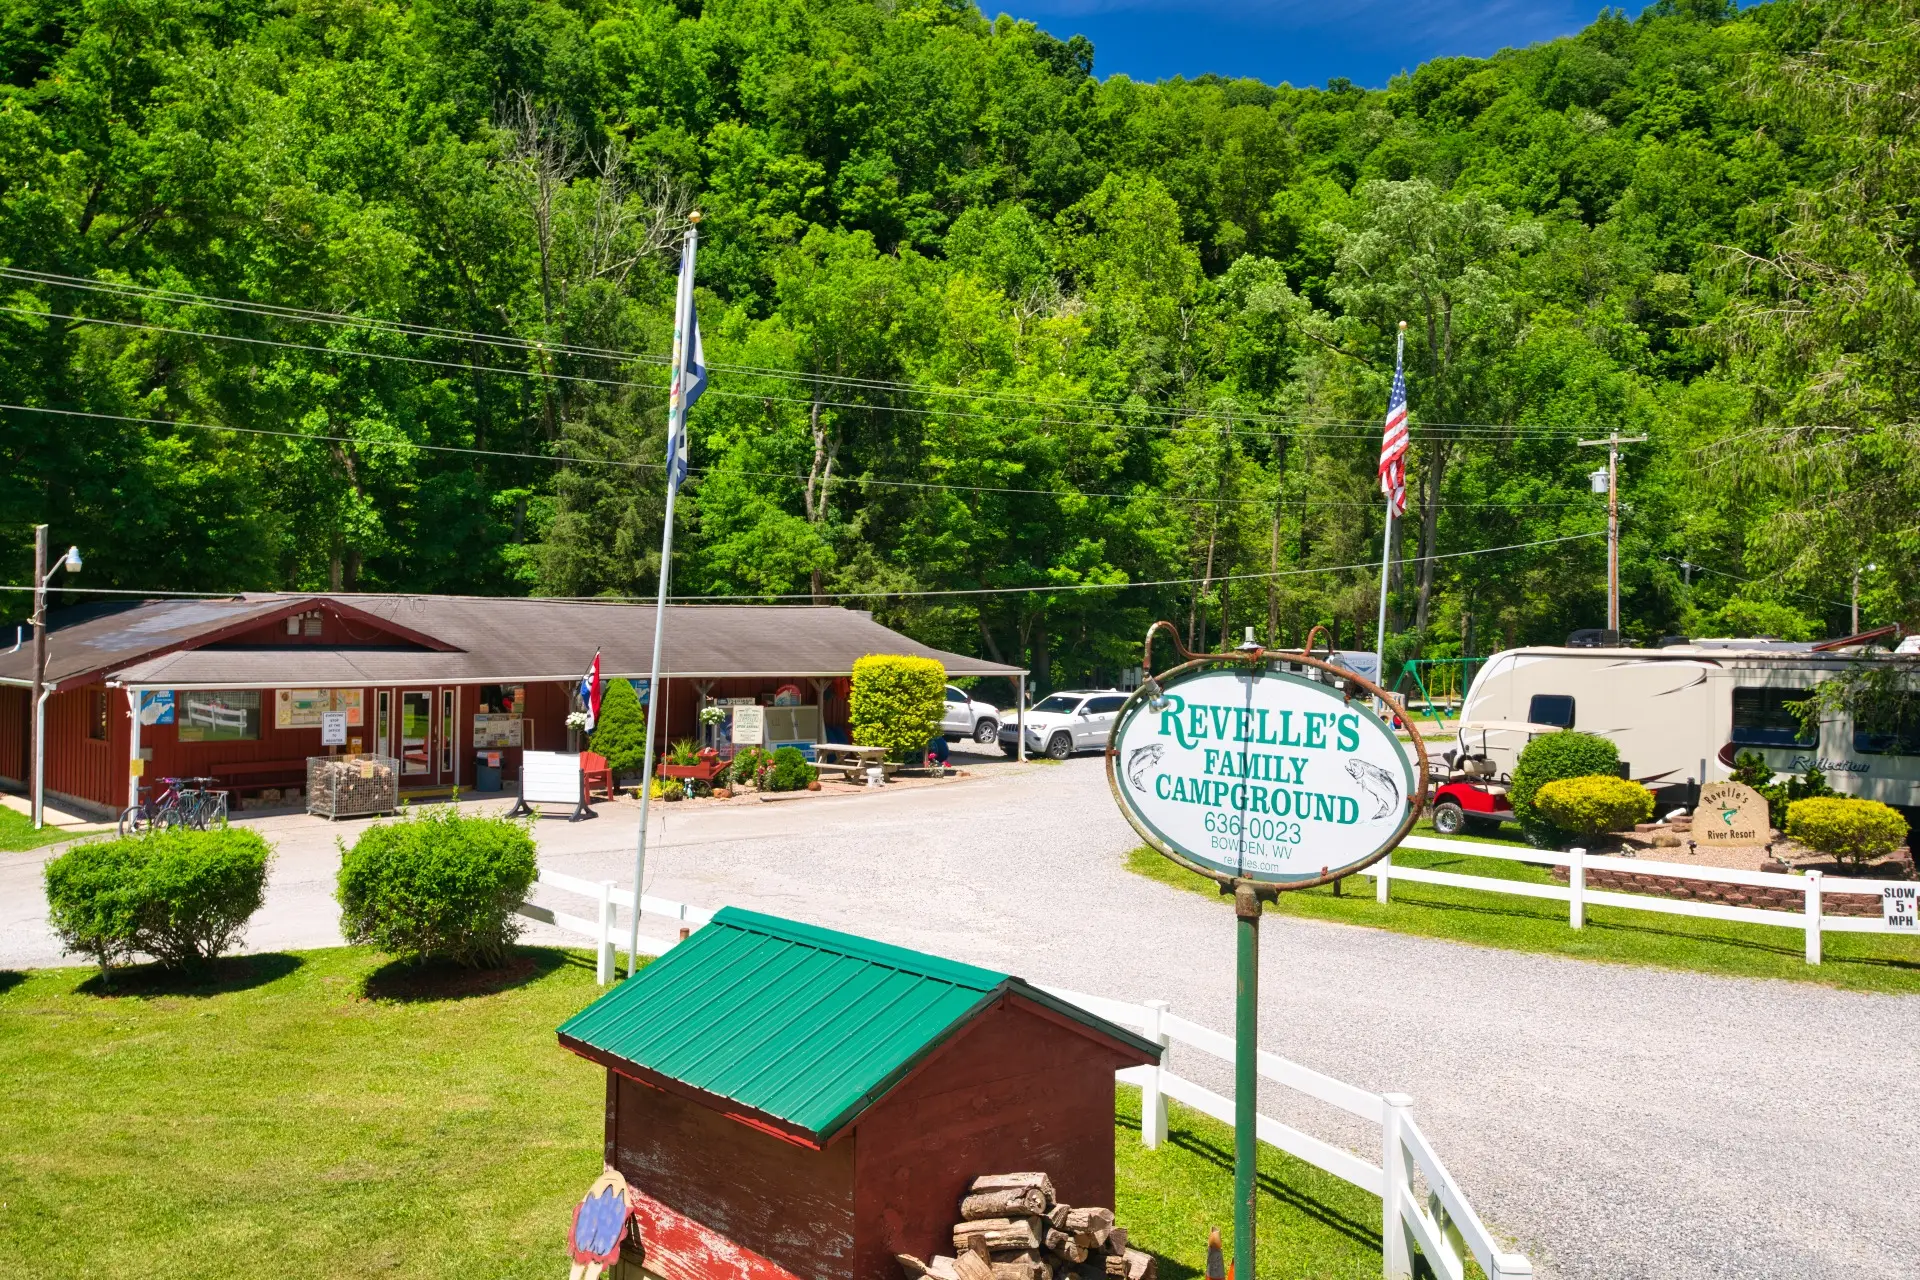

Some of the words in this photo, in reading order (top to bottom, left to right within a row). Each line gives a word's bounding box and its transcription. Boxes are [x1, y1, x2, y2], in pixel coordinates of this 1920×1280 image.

[1157, 694, 1360, 753] REVELLE'S
[1203, 748, 1309, 785] FAMILY
[1787, 755, 1871, 773] Reflection
[1155, 773, 1360, 825] CAMPGROUND
[1703, 787, 1749, 805] Revelle's
[1204, 811, 1301, 845] 636-0023
[1707, 830, 1728, 840] River
[1729, 829, 1756, 839] Resort
[1211, 835, 1268, 858] BOWDEN,
[1272, 844, 1293, 860] WV
[1223, 855, 1279, 873] revelles.com
[1883, 887, 1916, 899] SLOW
[1895, 900, 1905, 913] 5
[1888, 915, 1914, 926] MPH
